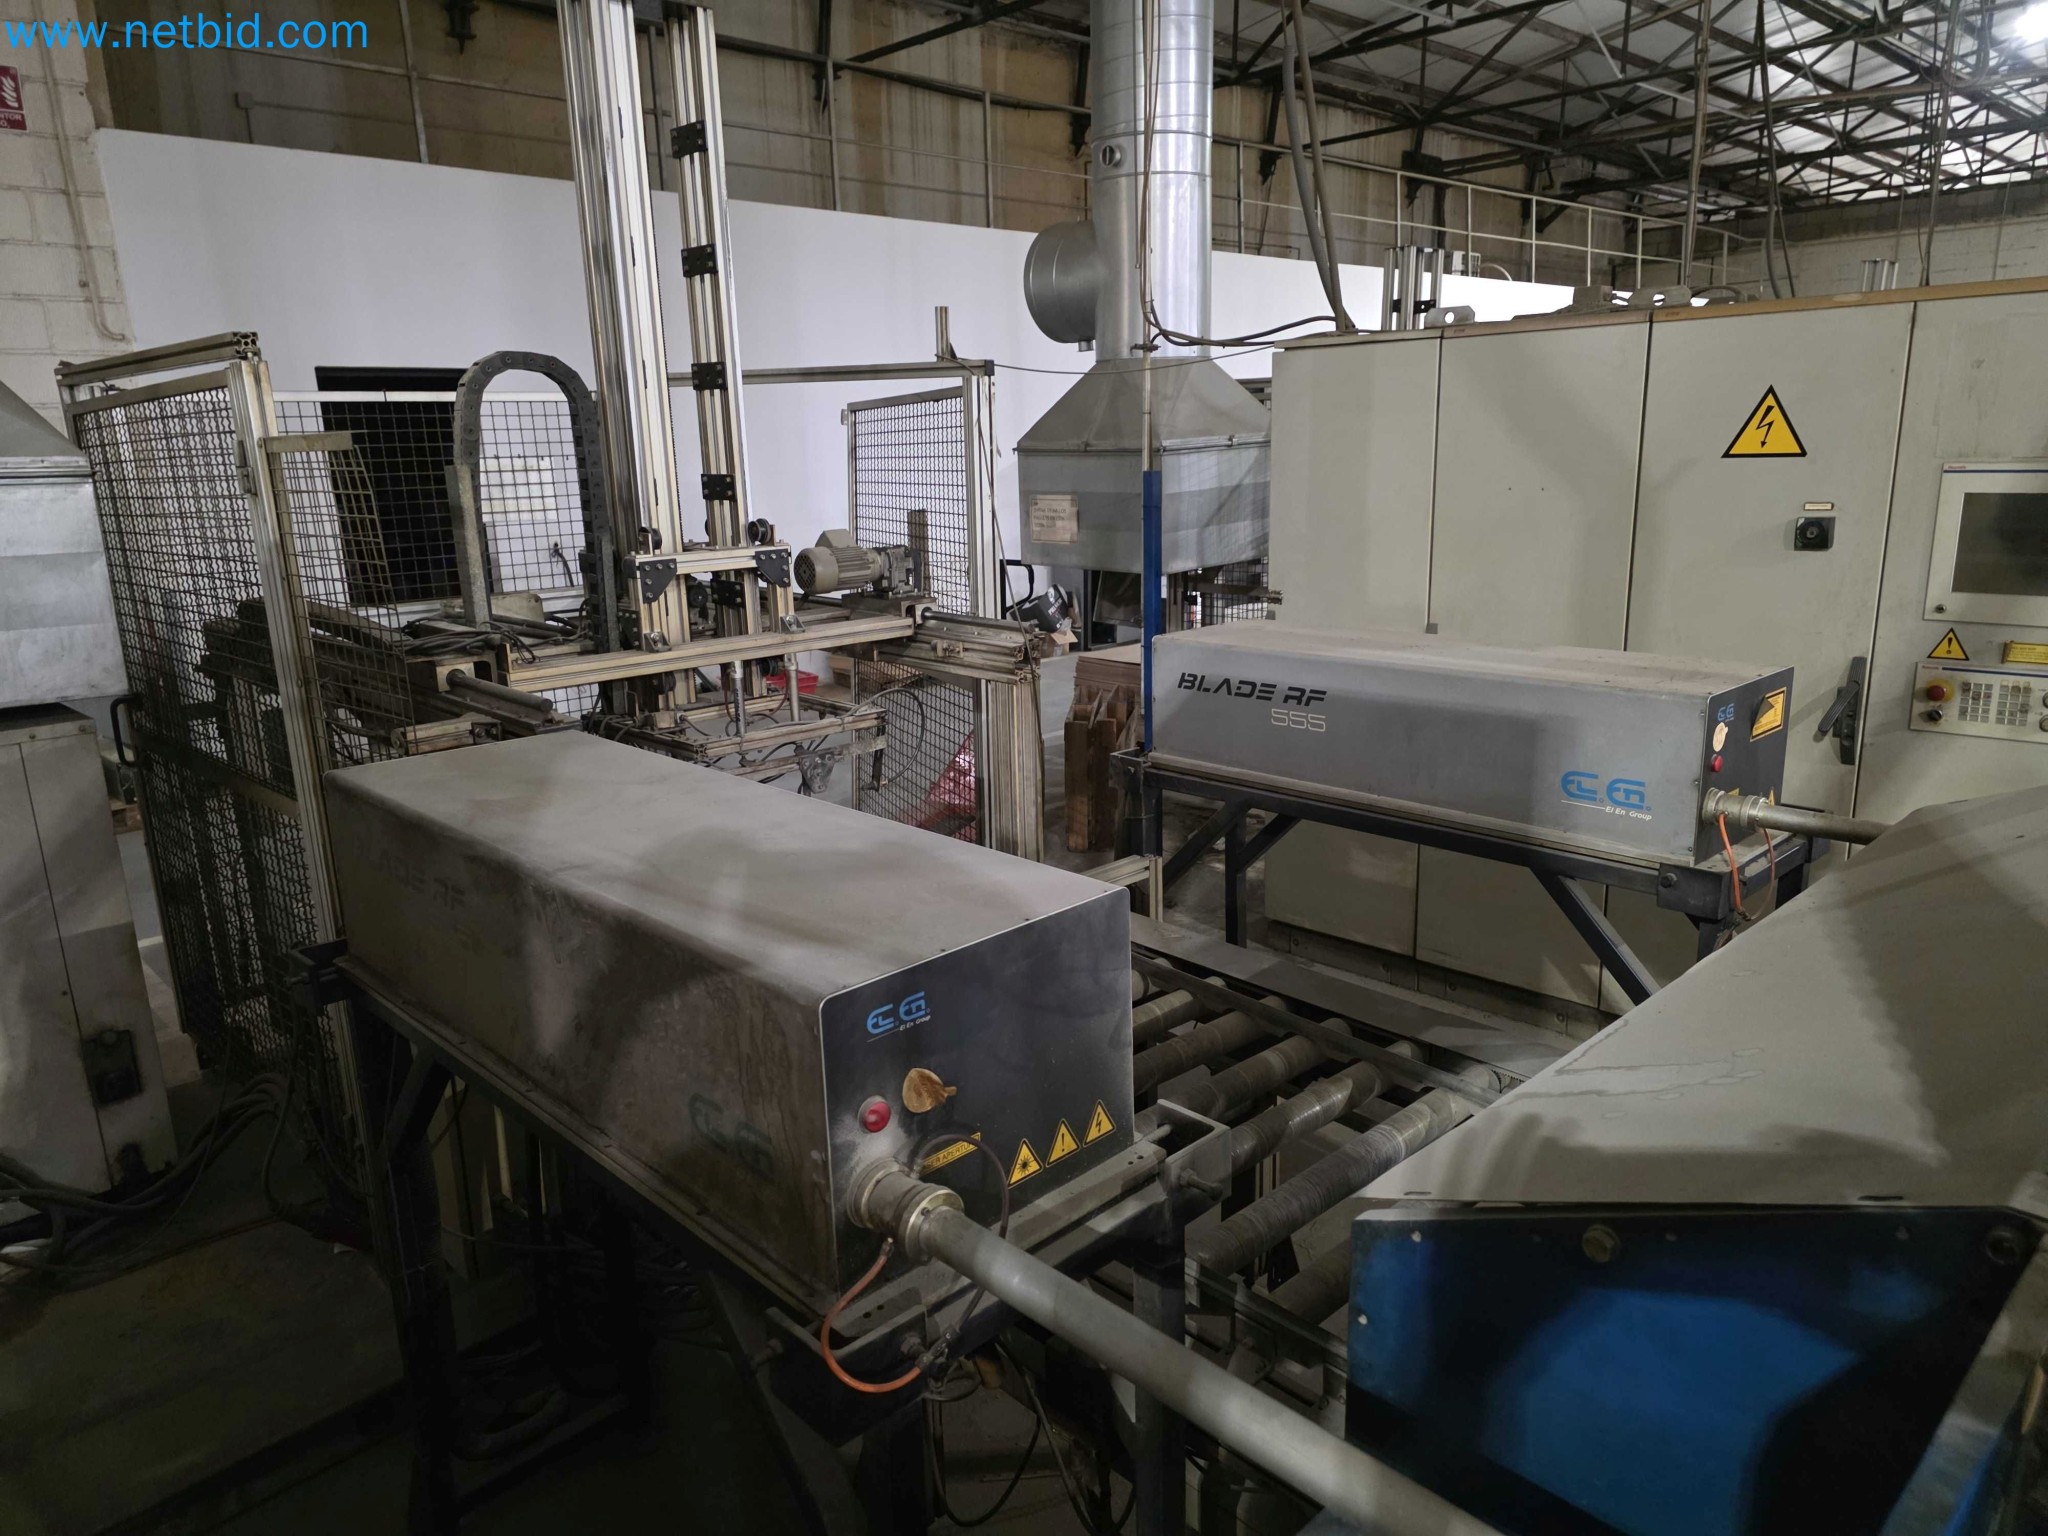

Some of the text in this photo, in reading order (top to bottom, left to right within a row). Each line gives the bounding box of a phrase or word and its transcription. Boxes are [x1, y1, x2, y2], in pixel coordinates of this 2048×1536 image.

[1177, 672, 1327, 706] BLADE RF
[1615, 807, 1626, 815] En
[1629, 810, 1652, 821] Group
